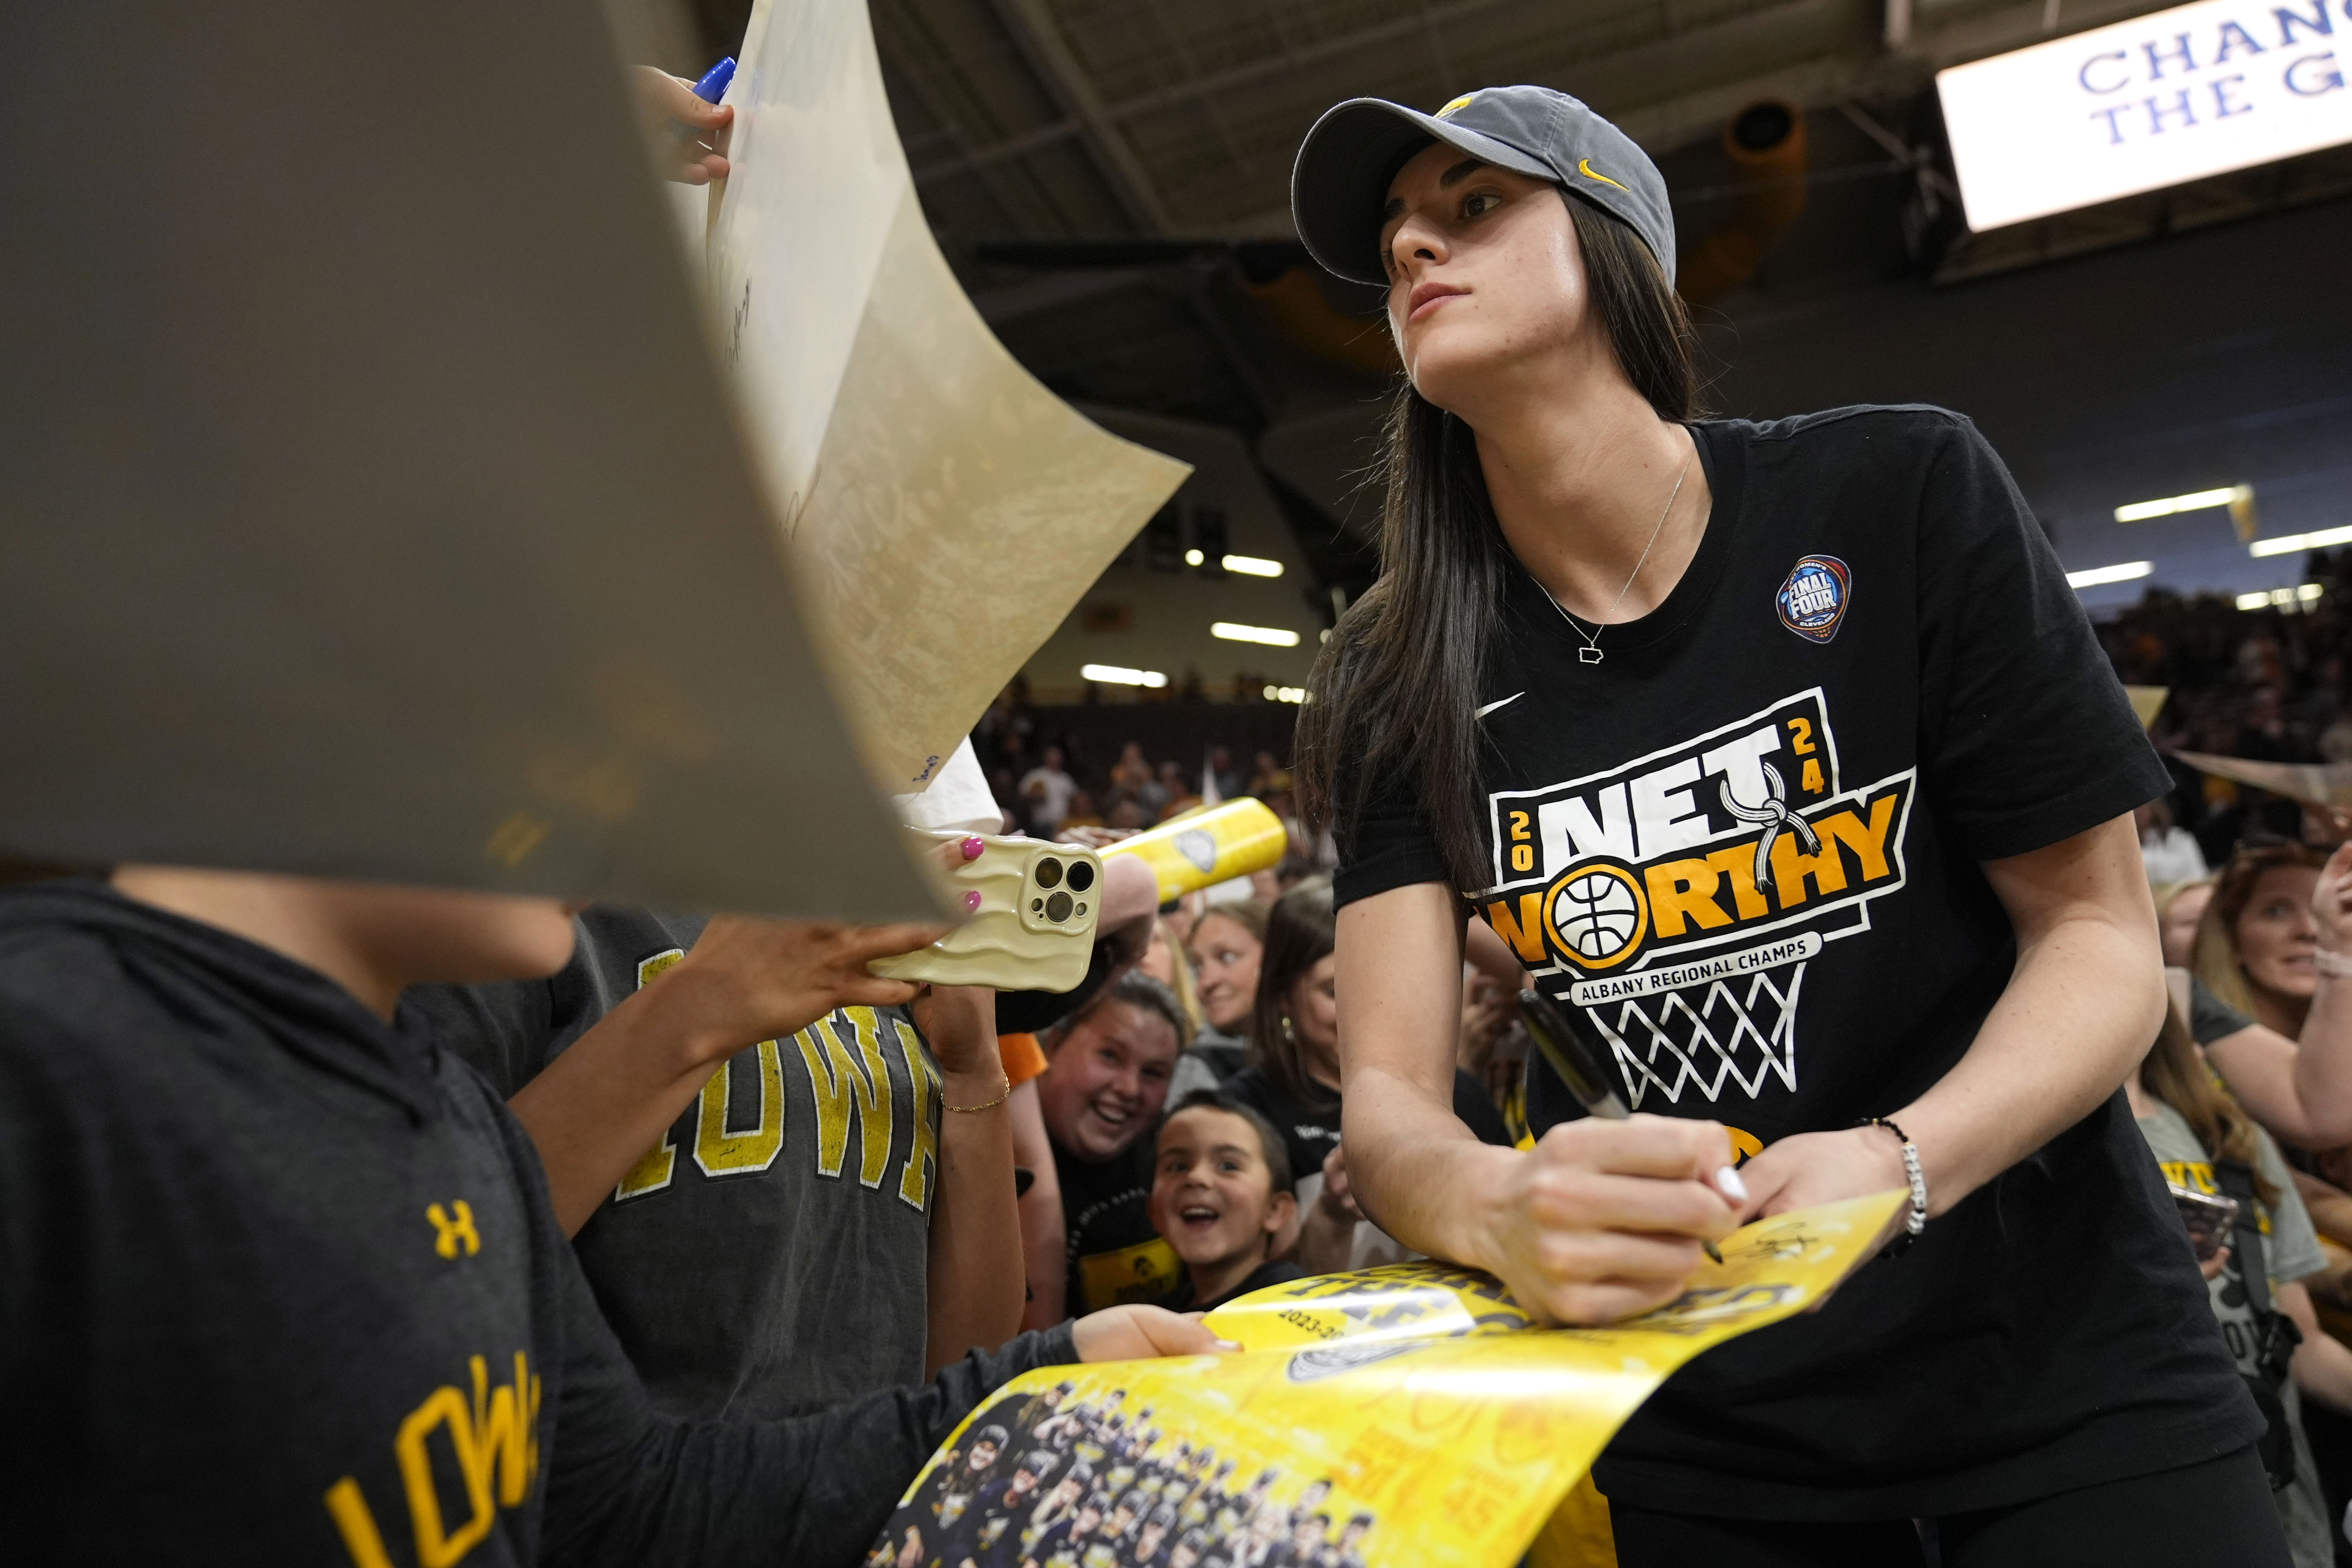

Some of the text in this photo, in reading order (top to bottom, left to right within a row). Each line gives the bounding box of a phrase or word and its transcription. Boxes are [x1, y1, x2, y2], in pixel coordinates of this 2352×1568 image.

[2079, 0, 2352, 94] CHAN
[2089, 74, 2253, 145] THE
[1789, 572, 1832, 603] FINAL
[1796, 562, 1826, 571] WOMEN'S
[1789, 588, 1837, 619] FOUR
[1800, 613, 1835, 626] CLEVELAND
[1787, 717, 1824, 794] 24
[1538, 724, 1781, 865] NET
[1509, 811, 1534, 872] 20
[1473, 793, 1898, 969] WORTHY
[1581, 940, 1807, 1000] ALBANY REGIONAL CHAMPS
